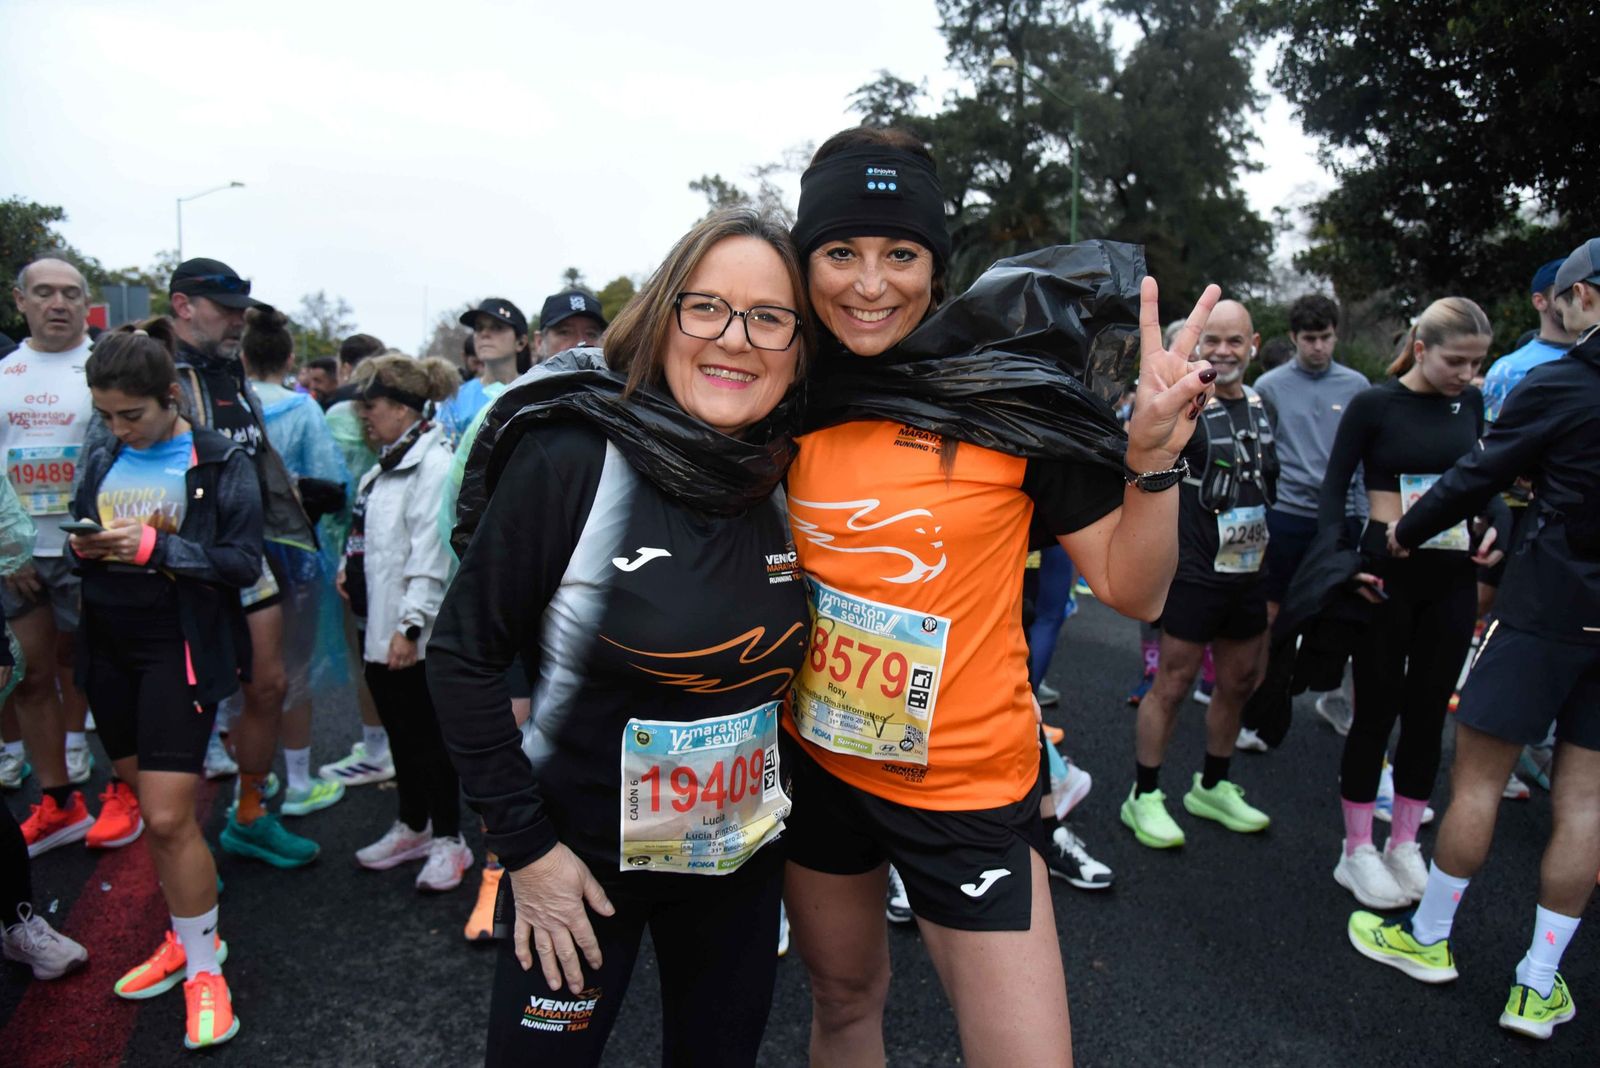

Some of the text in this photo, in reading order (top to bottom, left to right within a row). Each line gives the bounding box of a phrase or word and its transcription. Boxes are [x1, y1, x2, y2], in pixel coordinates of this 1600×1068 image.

[24, 392, 60, 406] edp
[893, 440, 929, 451] RUNNING
[9, 461, 76, 485] 19489
[98, 487, 167, 507] MEDIO
[769, 575, 793, 584] RUNNING
[829, 594, 887, 622] maratón
[840, 608, 886, 632] sevilla
[810, 626, 909, 699] 8579
[828, 681, 847, 698] Roxy
[823, 695, 887, 721] Dimastromatteo
[689, 717, 749, 738] maratón
[835, 711, 854, 722] enero
[855, 716, 871, 727] 2026
[704, 727, 749, 746] sevilla
[811, 726, 832, 742] HOKA
[837, 736, 869, 751] Sprinter
[884, 763, 929, 775] VENICE
[641, 748, 764, 814] 19409
[628, 788, 639, 821] CAJÓN
[687, 861, 716, 869] HOKA
[530, 995, 598, 1012] VENICE
[524, 1005, 593, 1020] MARATHON
[520, 1018, 590, 1032] RUNNING TEAM
